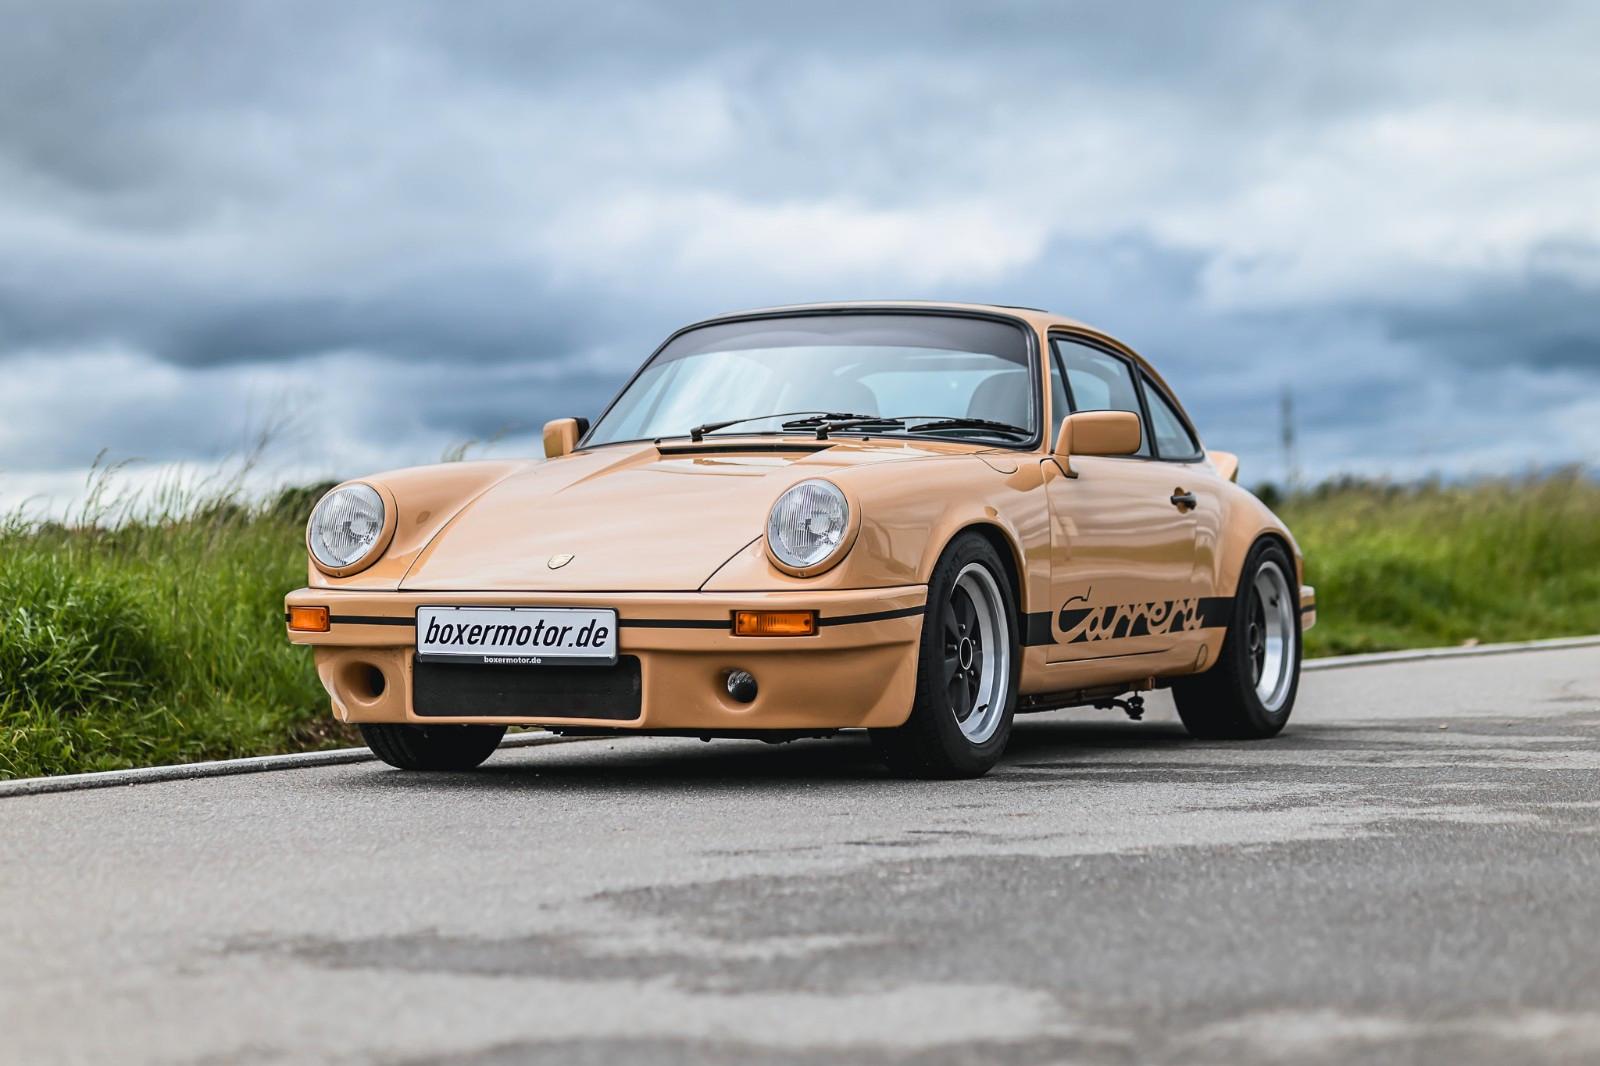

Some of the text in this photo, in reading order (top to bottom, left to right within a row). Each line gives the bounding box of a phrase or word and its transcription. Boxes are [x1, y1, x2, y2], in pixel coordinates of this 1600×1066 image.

[1051, 585, 1204, 644] Carrera
[424, 616, 609, 647] boxermotor.de
[483, 656, 542, 664] boxermotor.de
